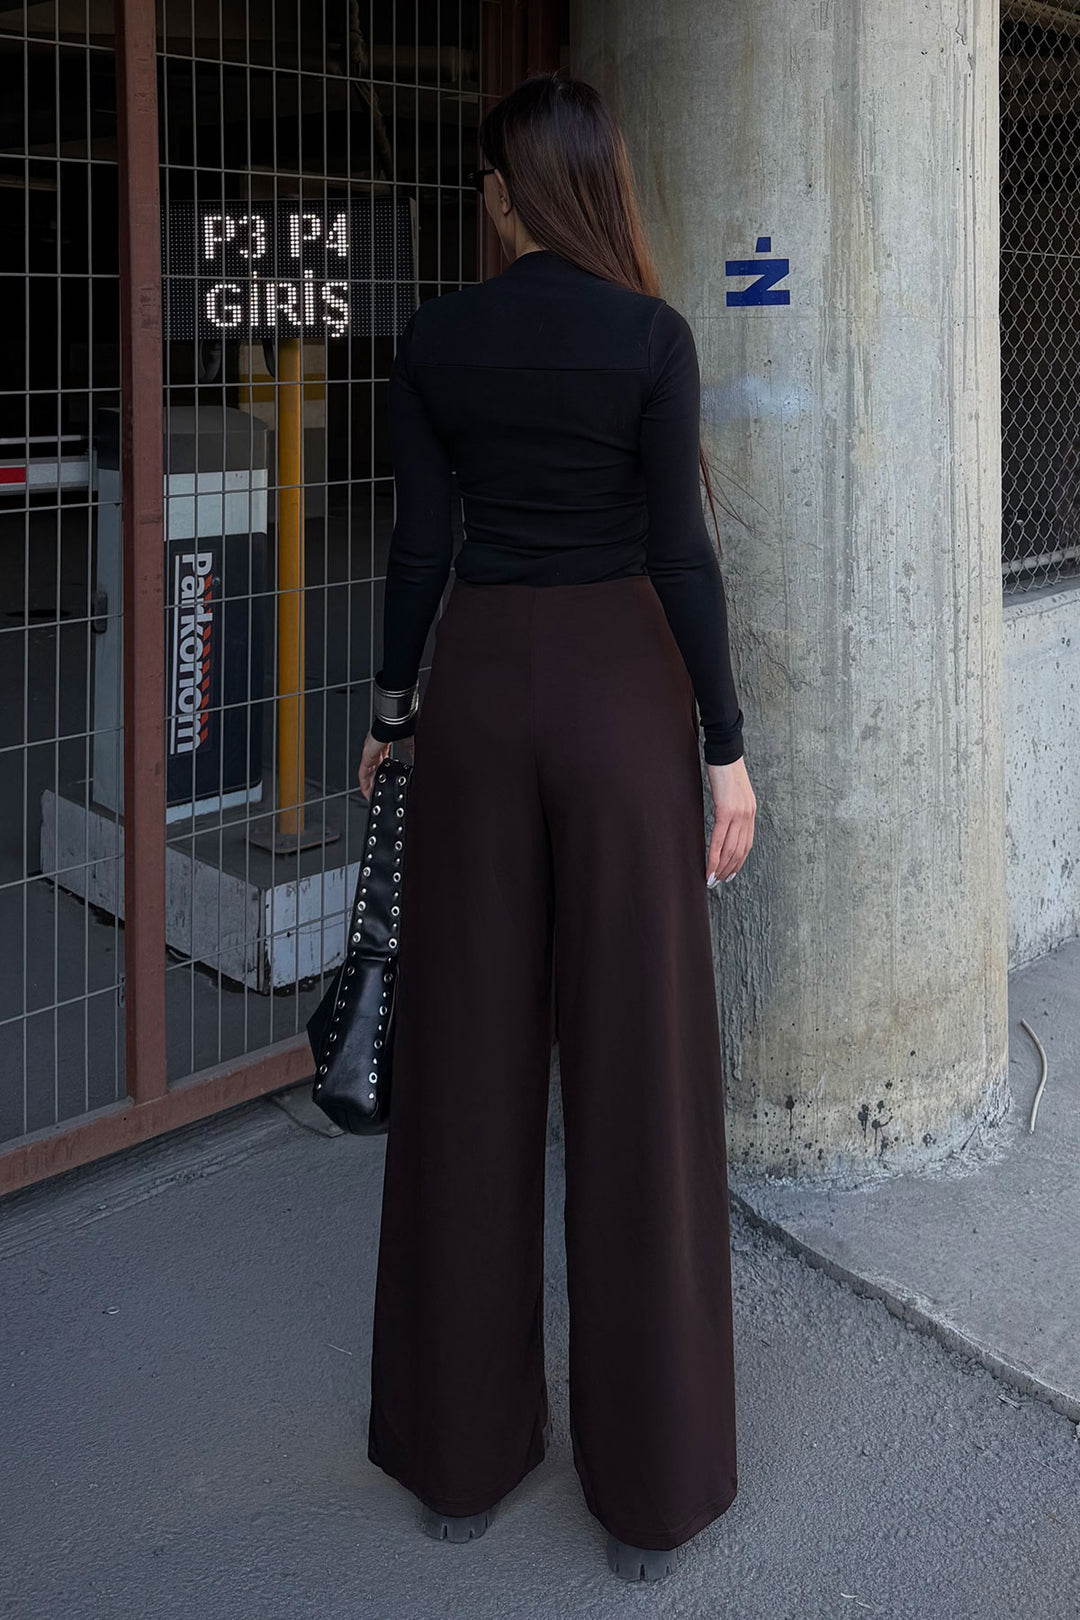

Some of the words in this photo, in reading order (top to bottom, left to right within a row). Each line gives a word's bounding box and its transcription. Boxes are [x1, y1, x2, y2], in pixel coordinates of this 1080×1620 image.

[204, 214, 265, 259] P3
[290, 213, 349, 257] P4
[177, 552, 213, 754] Parkonom
